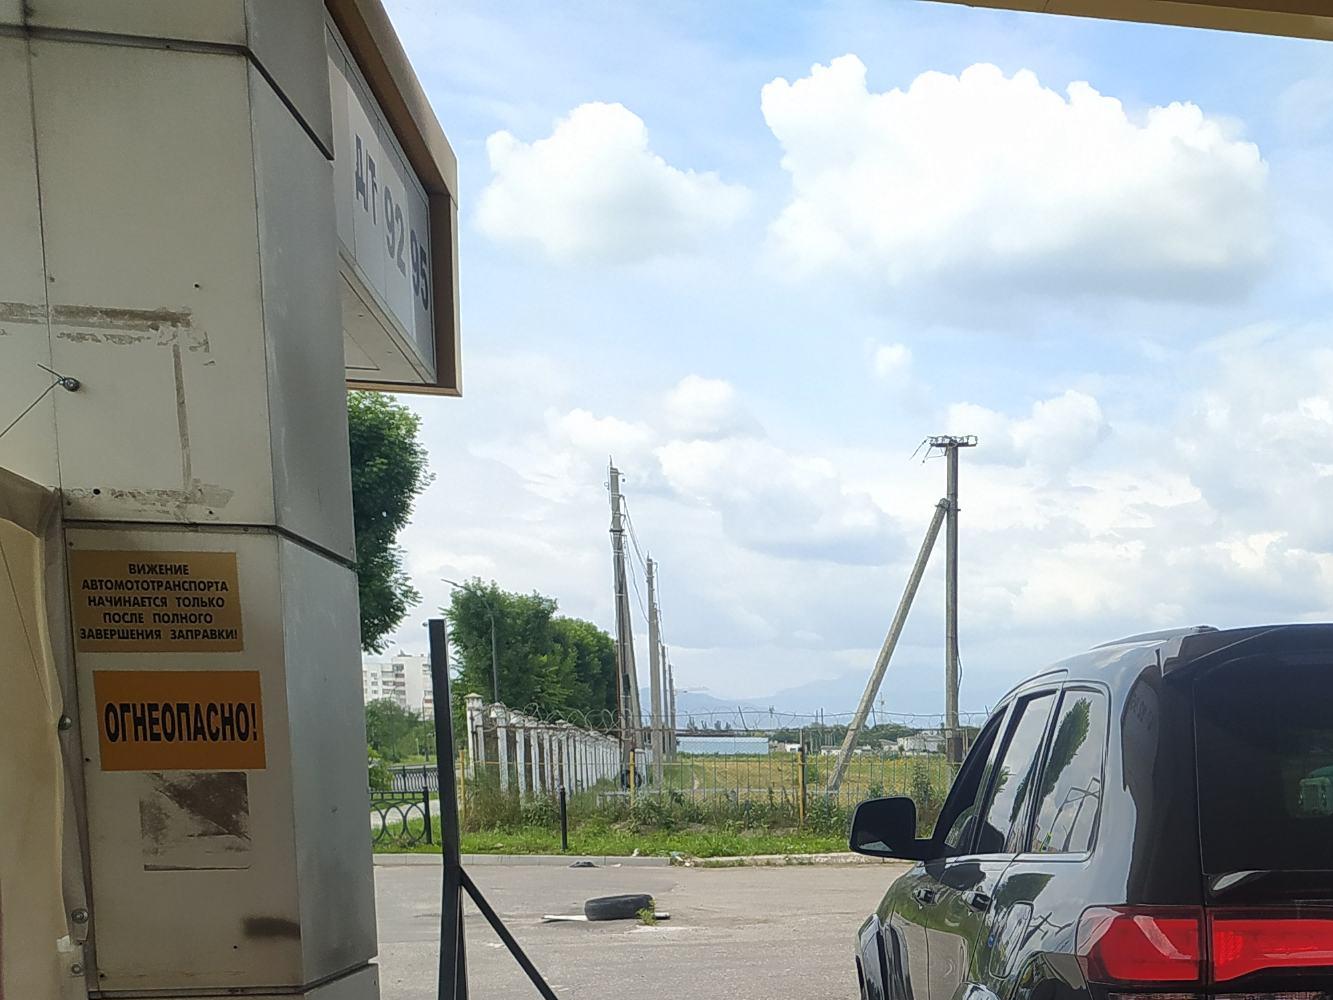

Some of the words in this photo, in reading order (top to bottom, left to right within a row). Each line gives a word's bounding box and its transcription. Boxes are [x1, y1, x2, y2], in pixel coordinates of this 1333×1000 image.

[384, 185, 406, 277] 92
[410, 229, 429, 311] 95
[128, 563, 189, 575] ВИЖЕНИЕ
[81, 579, 229, 592] АВТОМОТОТРАНСПОРТА
[87, 596, 168, 608] НАЧИНАЕТСЯ
[175, 597, 225, 608] ТОЛЬКО
[103, 612, 145, 624] ПОСЛЕ
[153, 613, 213, 624] ПОЛНОГО
[80, 628, 162, 640] ЗАВЕРШЕНИЯ
[170, 629, 238, 640] ЗАПРАВКИ!
[104, 702, 258, 742] ОГНЕОПАСНО!
